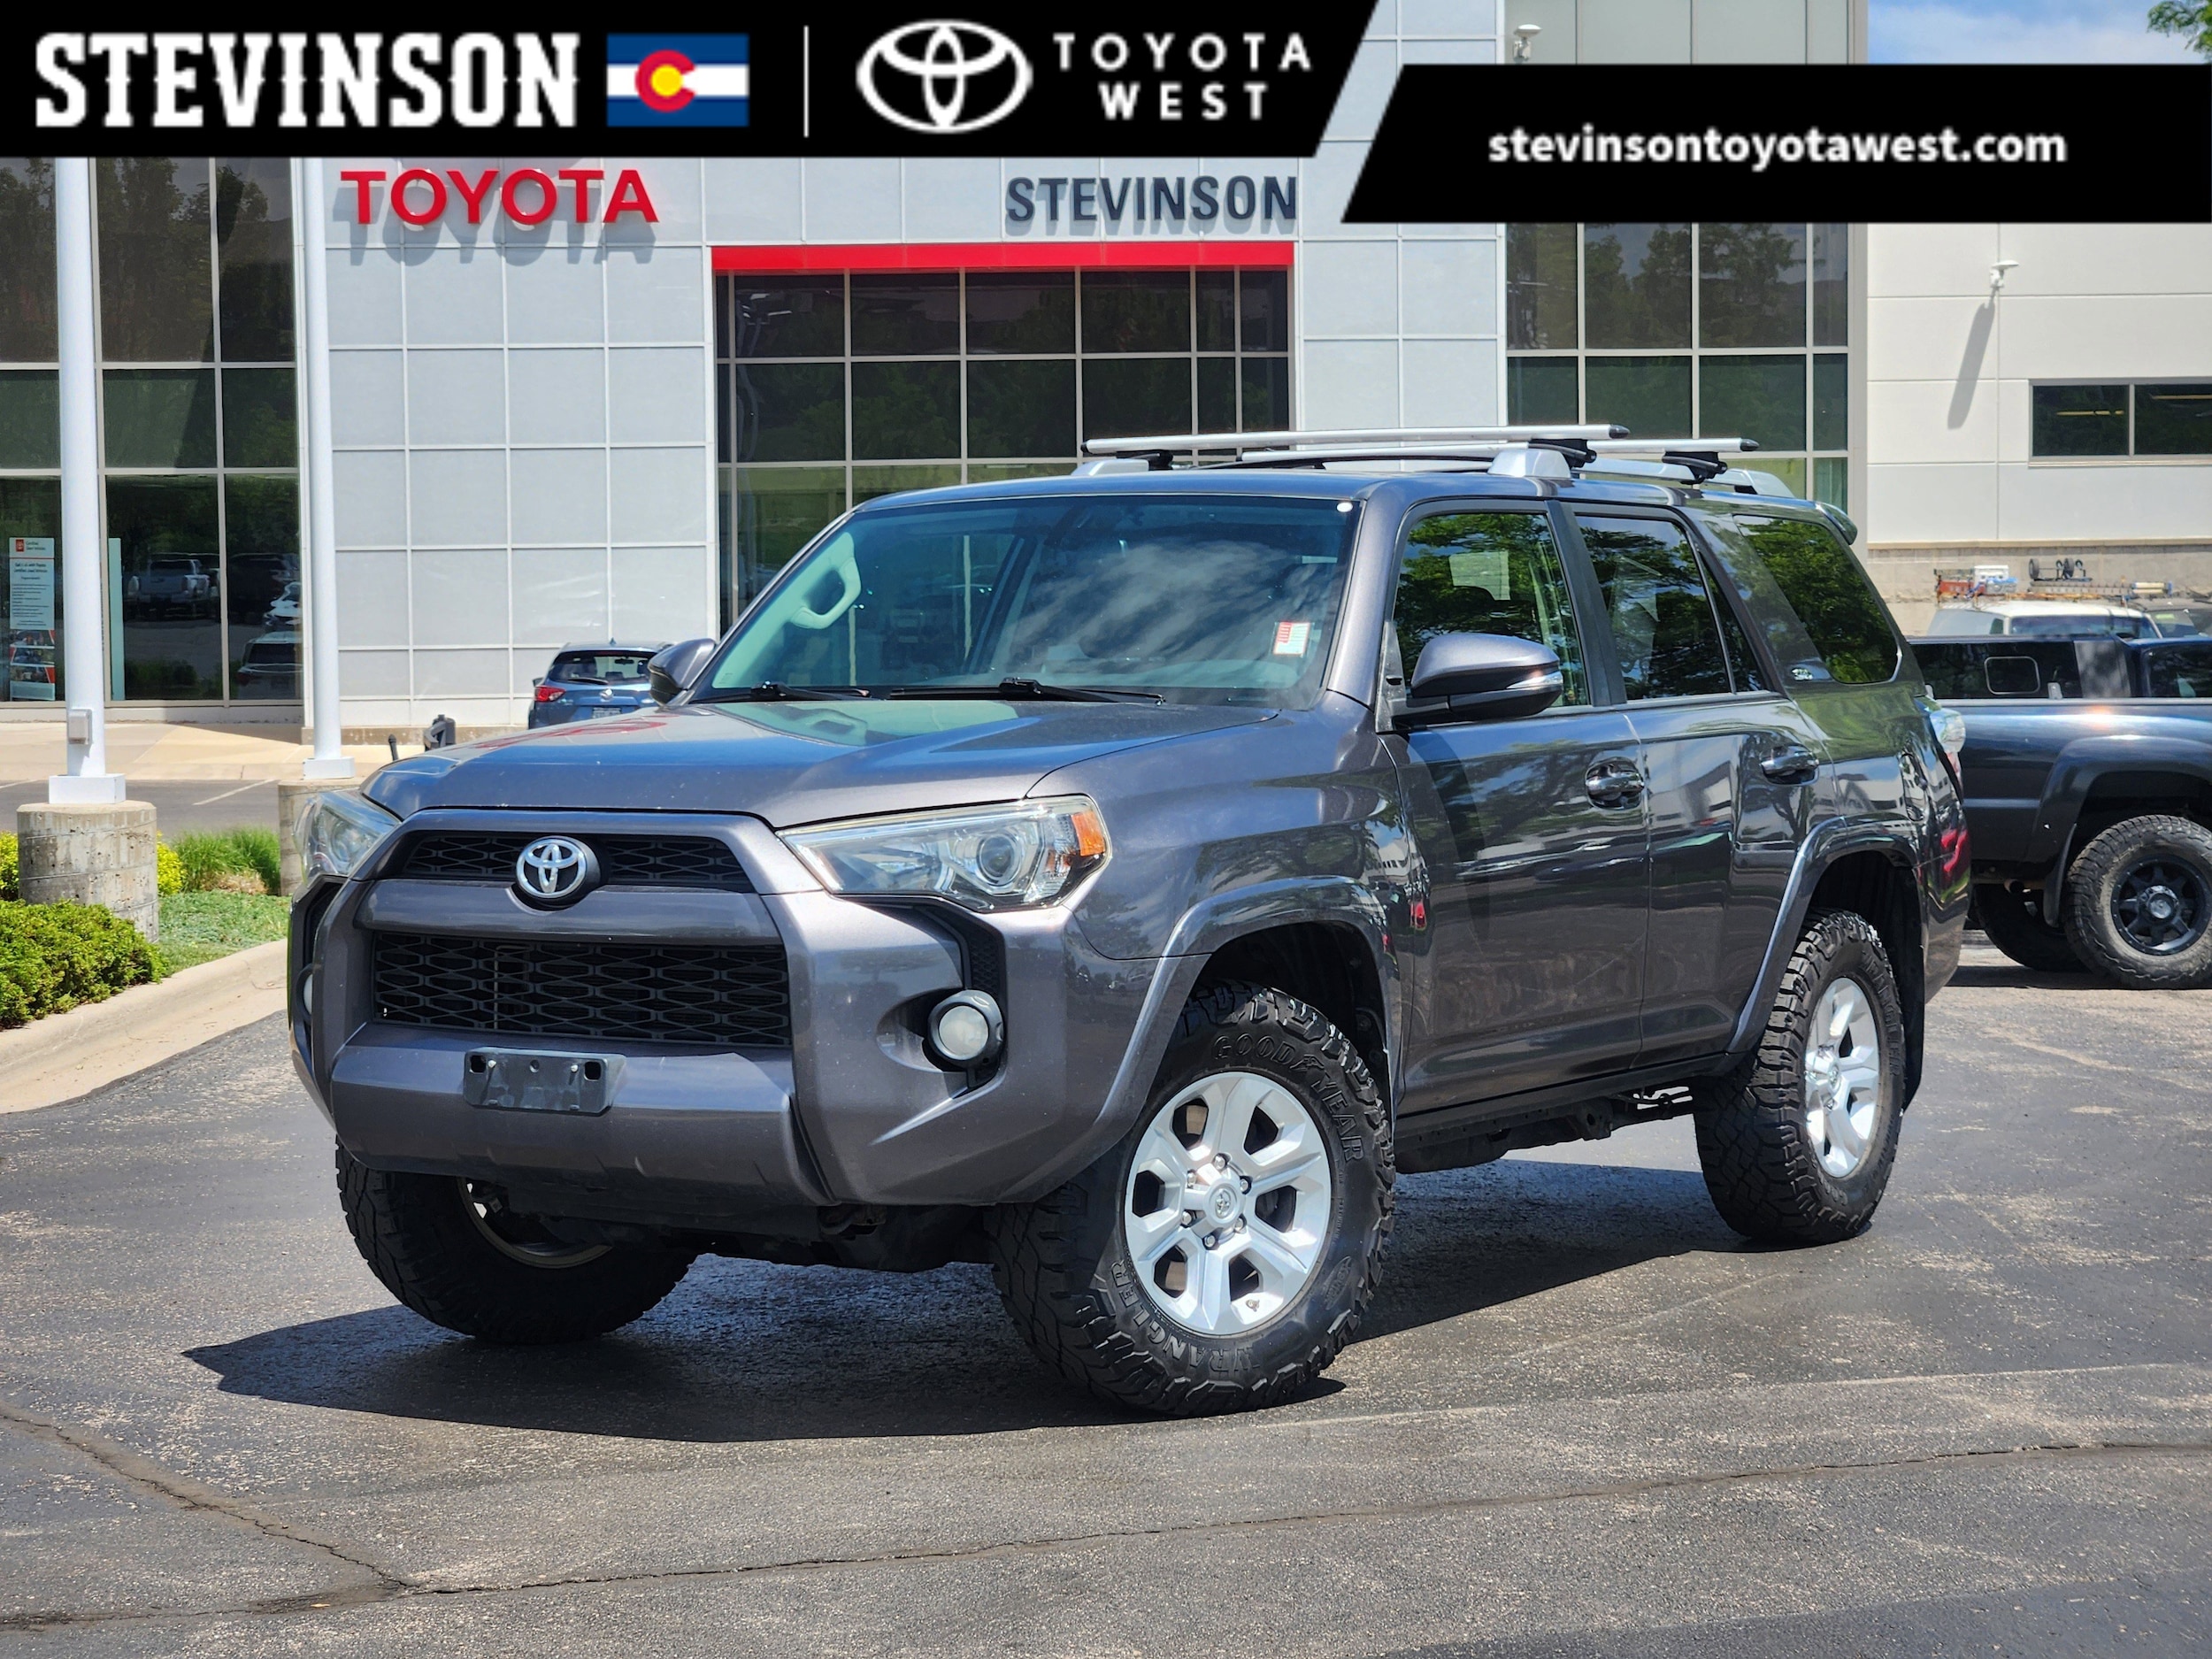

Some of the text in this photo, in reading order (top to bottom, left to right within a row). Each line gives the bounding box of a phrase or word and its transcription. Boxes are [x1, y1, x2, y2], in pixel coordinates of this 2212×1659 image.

[340, 168, 659, 225] TOYOTA
[1006, 175, 1296, 222] STEVINSON
[1110, 1258, 1261, 1373] WRANGLER
